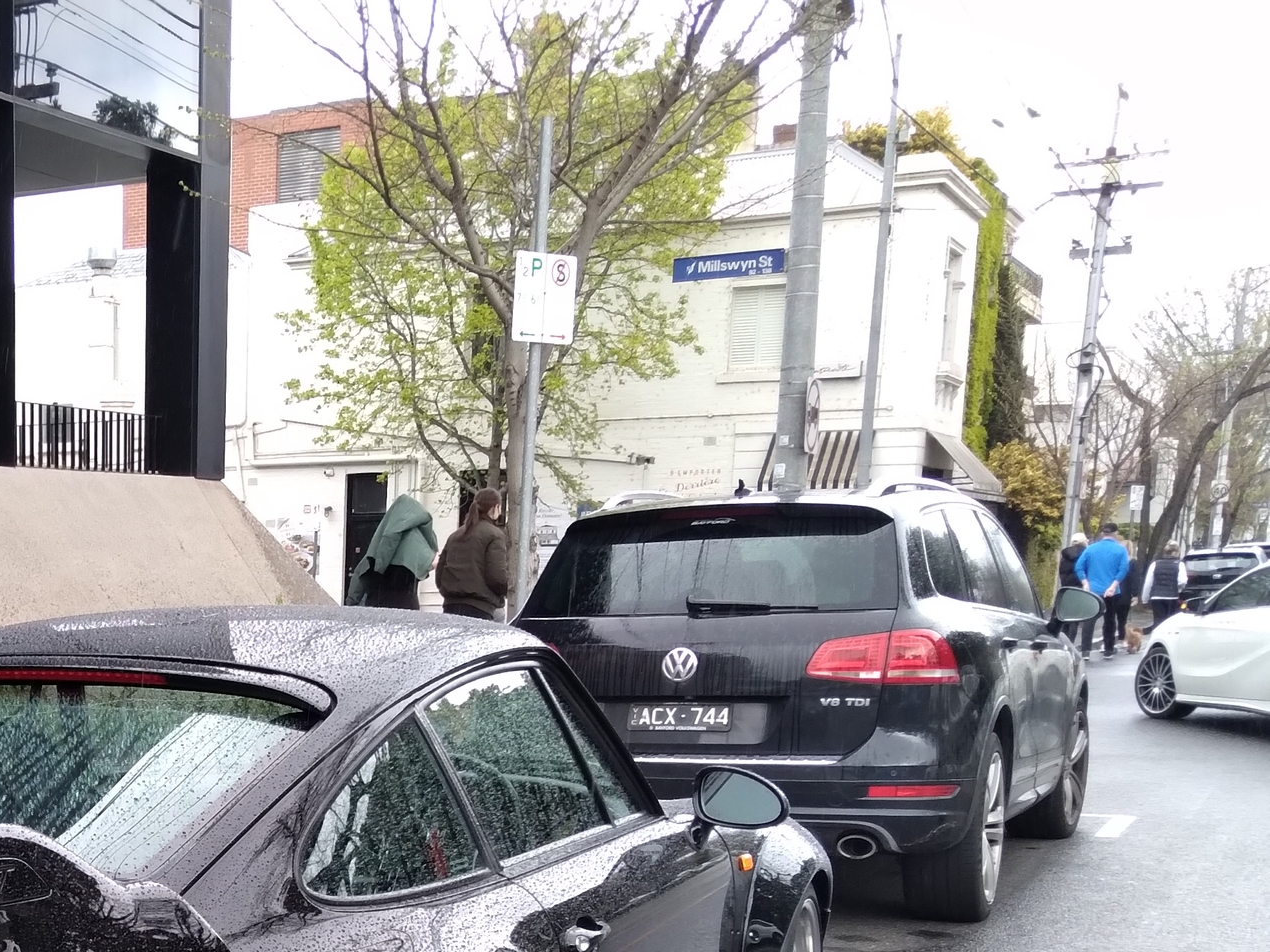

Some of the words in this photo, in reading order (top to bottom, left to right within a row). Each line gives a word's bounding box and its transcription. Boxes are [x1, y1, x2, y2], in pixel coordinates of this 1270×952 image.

[697, 259, 757, 273] Millswyn
[758, 255, 774, 268] St
[820, 697, 840, 707] V8
[845, 697, 871, 707] TDI
[638, 707, 677, 725] ACX
[690, 707, 729, 725] 744
